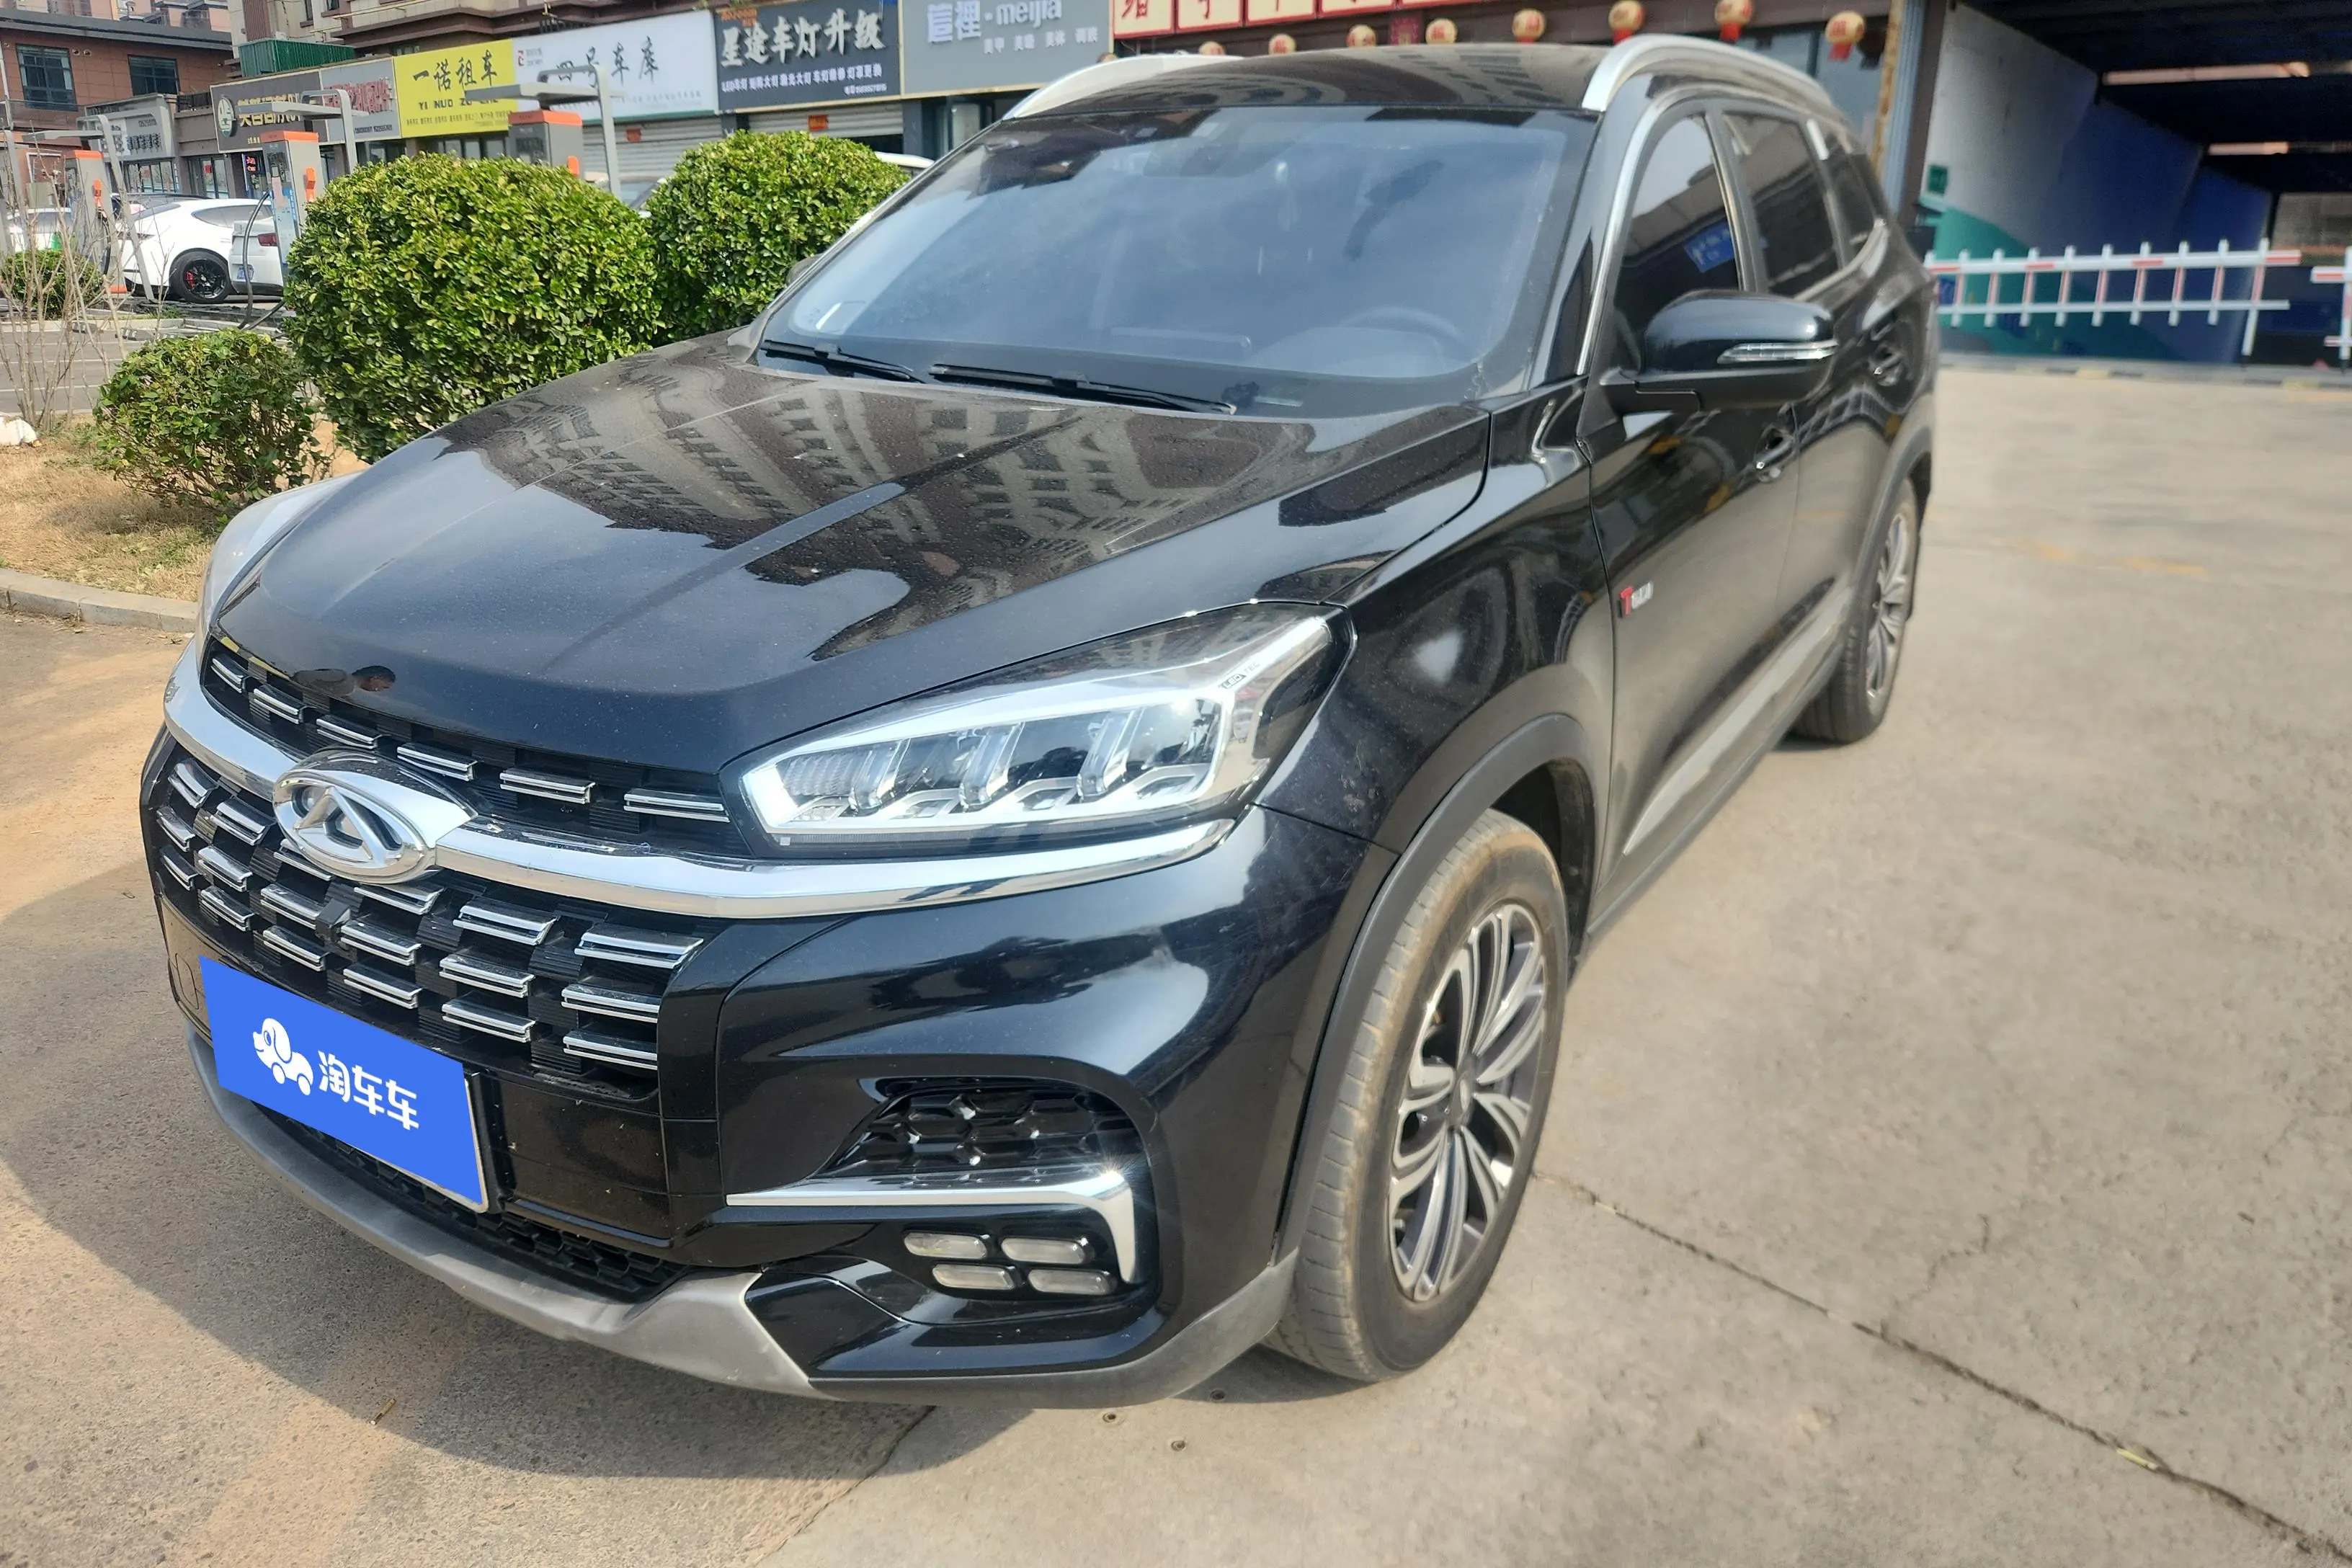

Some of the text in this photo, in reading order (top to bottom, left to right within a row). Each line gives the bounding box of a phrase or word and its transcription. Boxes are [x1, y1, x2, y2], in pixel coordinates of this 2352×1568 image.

[721, 8, 886, 67] 星途车灯升级
[413, 50, 497, 92] 一诺租车
[419, 102, 428, 110] YI
[435, 99, 453, 108] NUO
